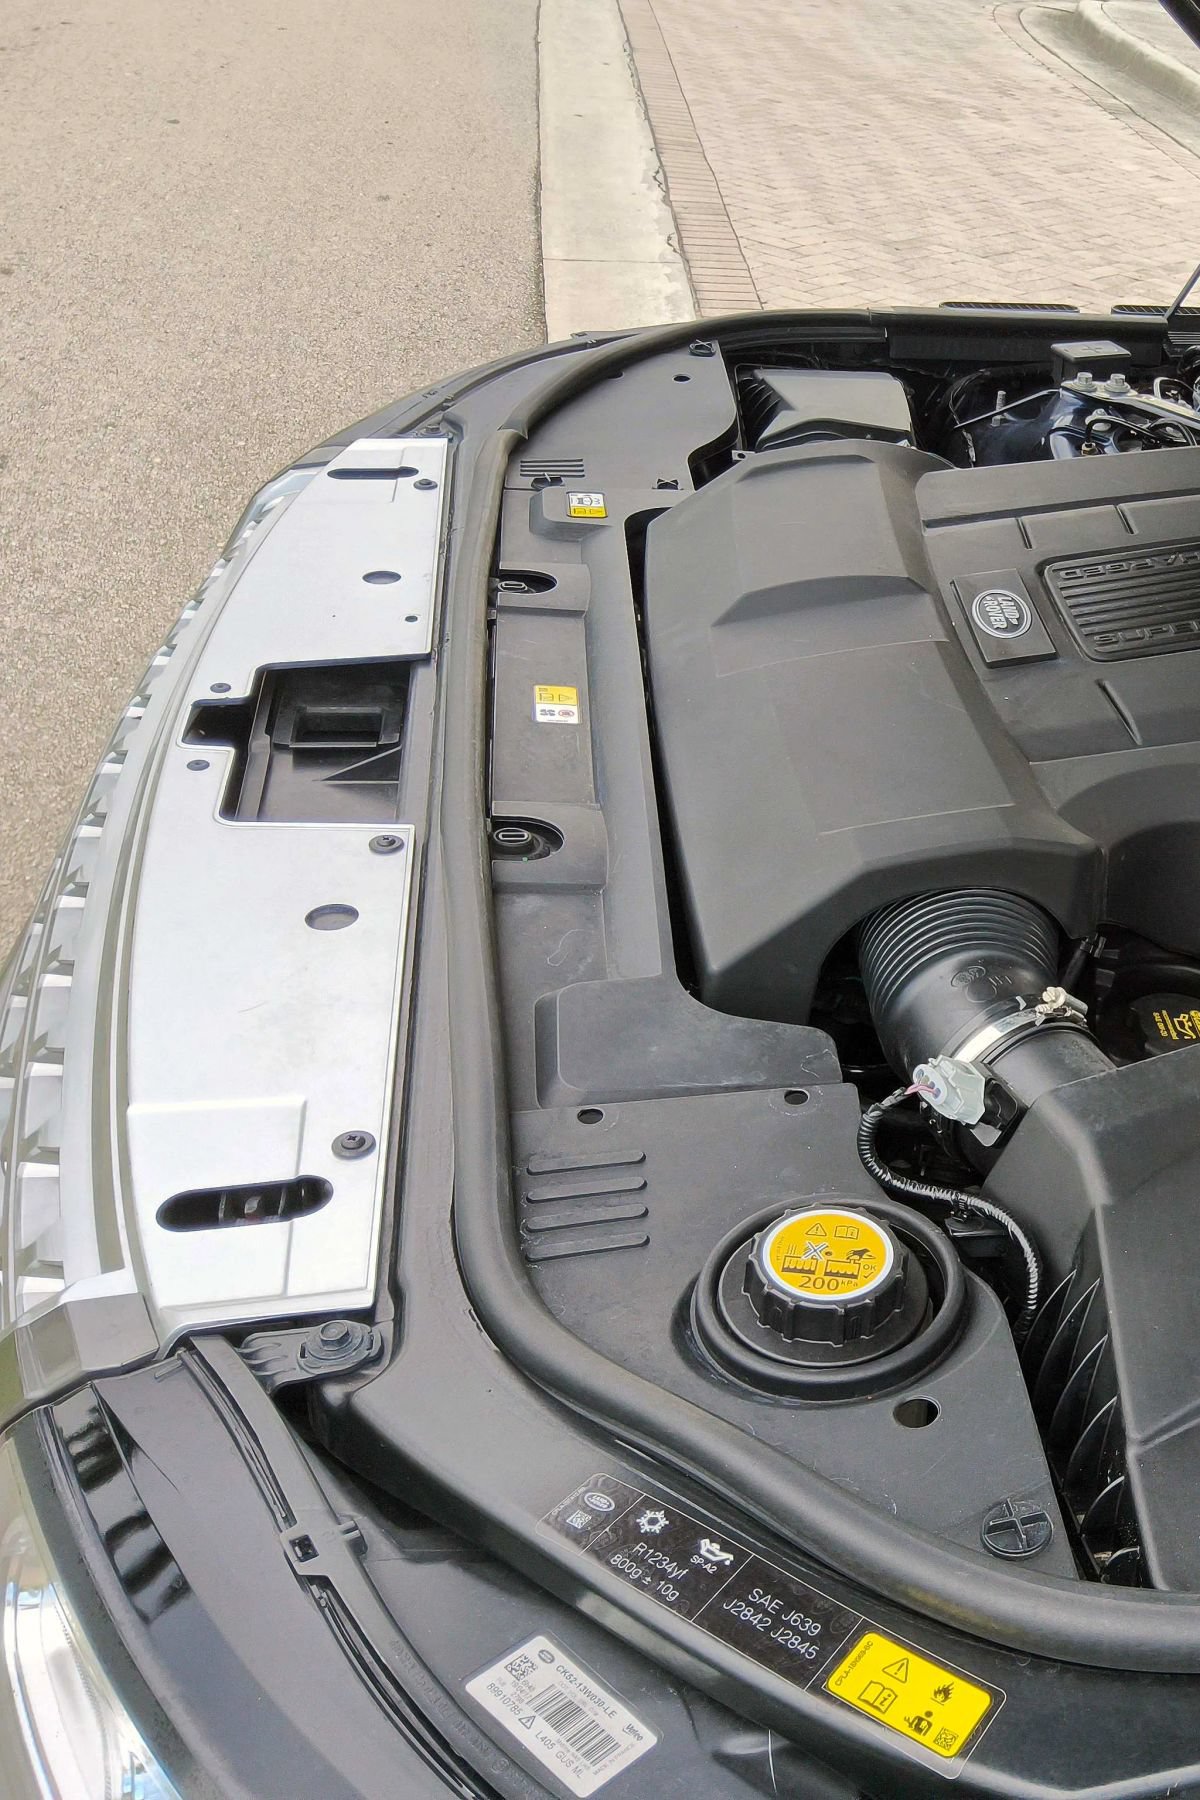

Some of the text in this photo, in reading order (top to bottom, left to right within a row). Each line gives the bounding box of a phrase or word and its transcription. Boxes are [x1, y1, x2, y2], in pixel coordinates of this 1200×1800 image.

[983, 596, 1008, 629] ROVER
[997, 596, 1020, 625] LAND
[799, 1276, 839, 1291] 200
[862, 1263, 877, 1271] OK
[610, 1553, 642, 1585] 800g
[655, 1578, 681, 1603] 10g
[631, 1541, 689, 1581] R1234yf
[690, 1554, 717, 1575] SP-A2
[722, 1599, 819, 1660] J2842 J2845
[748, 1588, 822, 1637] SAE J639
[486, 1682, 521, 1716] 89910785
[555, 1664, 617, 1719] CK52-13W030-LE
[623, 1723, 644, 1742] Valeo
[535, 1730, 555, 1750] L405
[555, 1751, 572, 1769] GUS
[572, 1764, 586, 1779] ML
